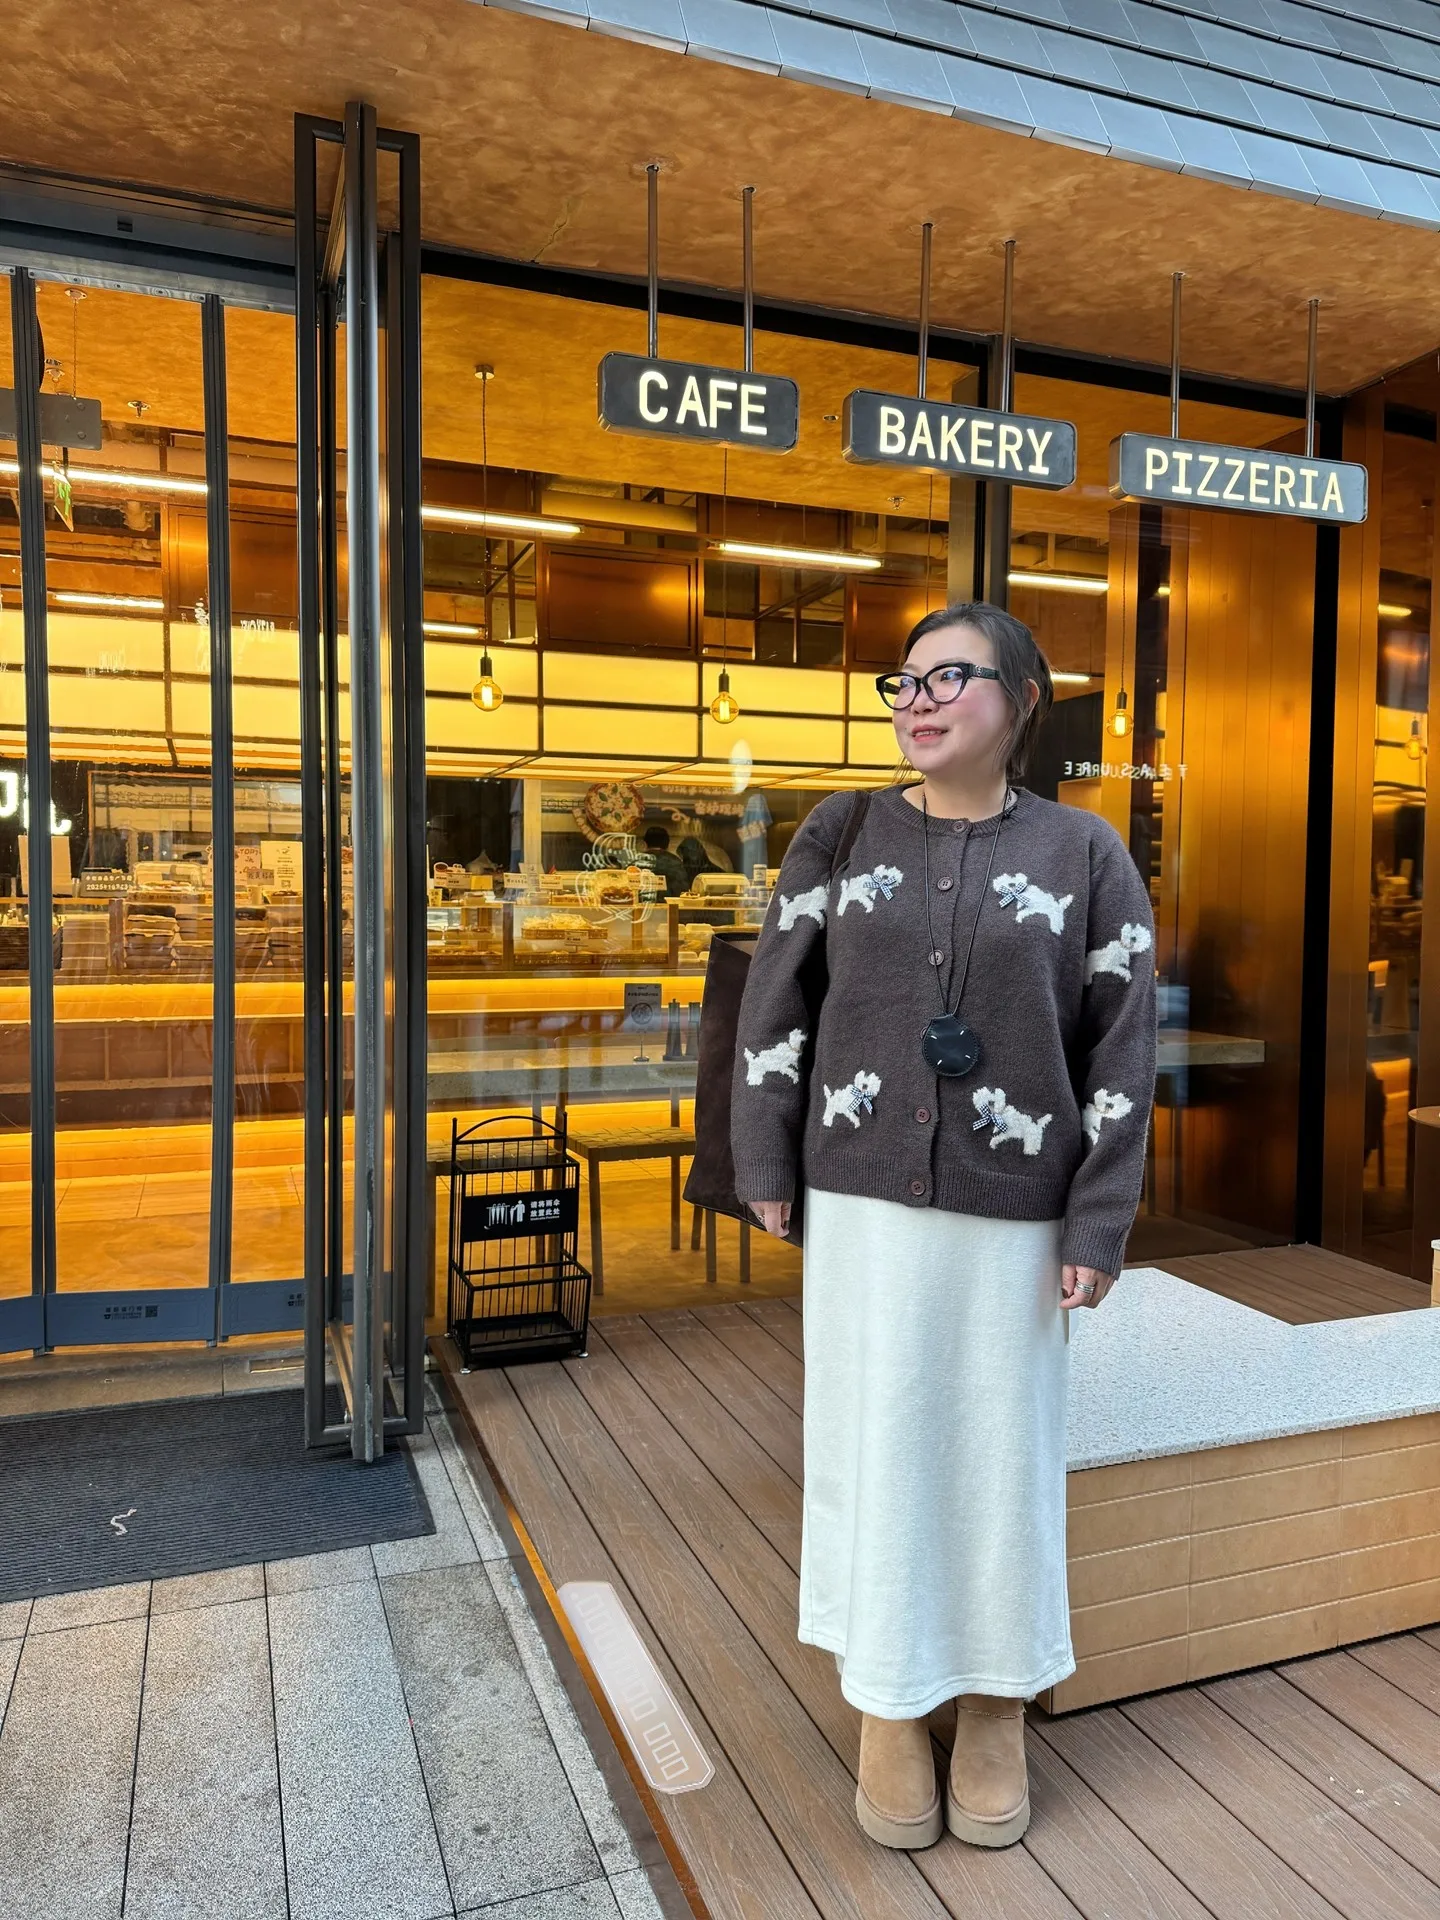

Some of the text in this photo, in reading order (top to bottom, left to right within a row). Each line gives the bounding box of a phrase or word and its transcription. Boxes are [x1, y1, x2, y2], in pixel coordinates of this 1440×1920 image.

[639, 370, 768, 435] CAFE
[879, 406, 1053, 475] BAKERY
[1145, 447, 1344, 514] PIZZERIA
